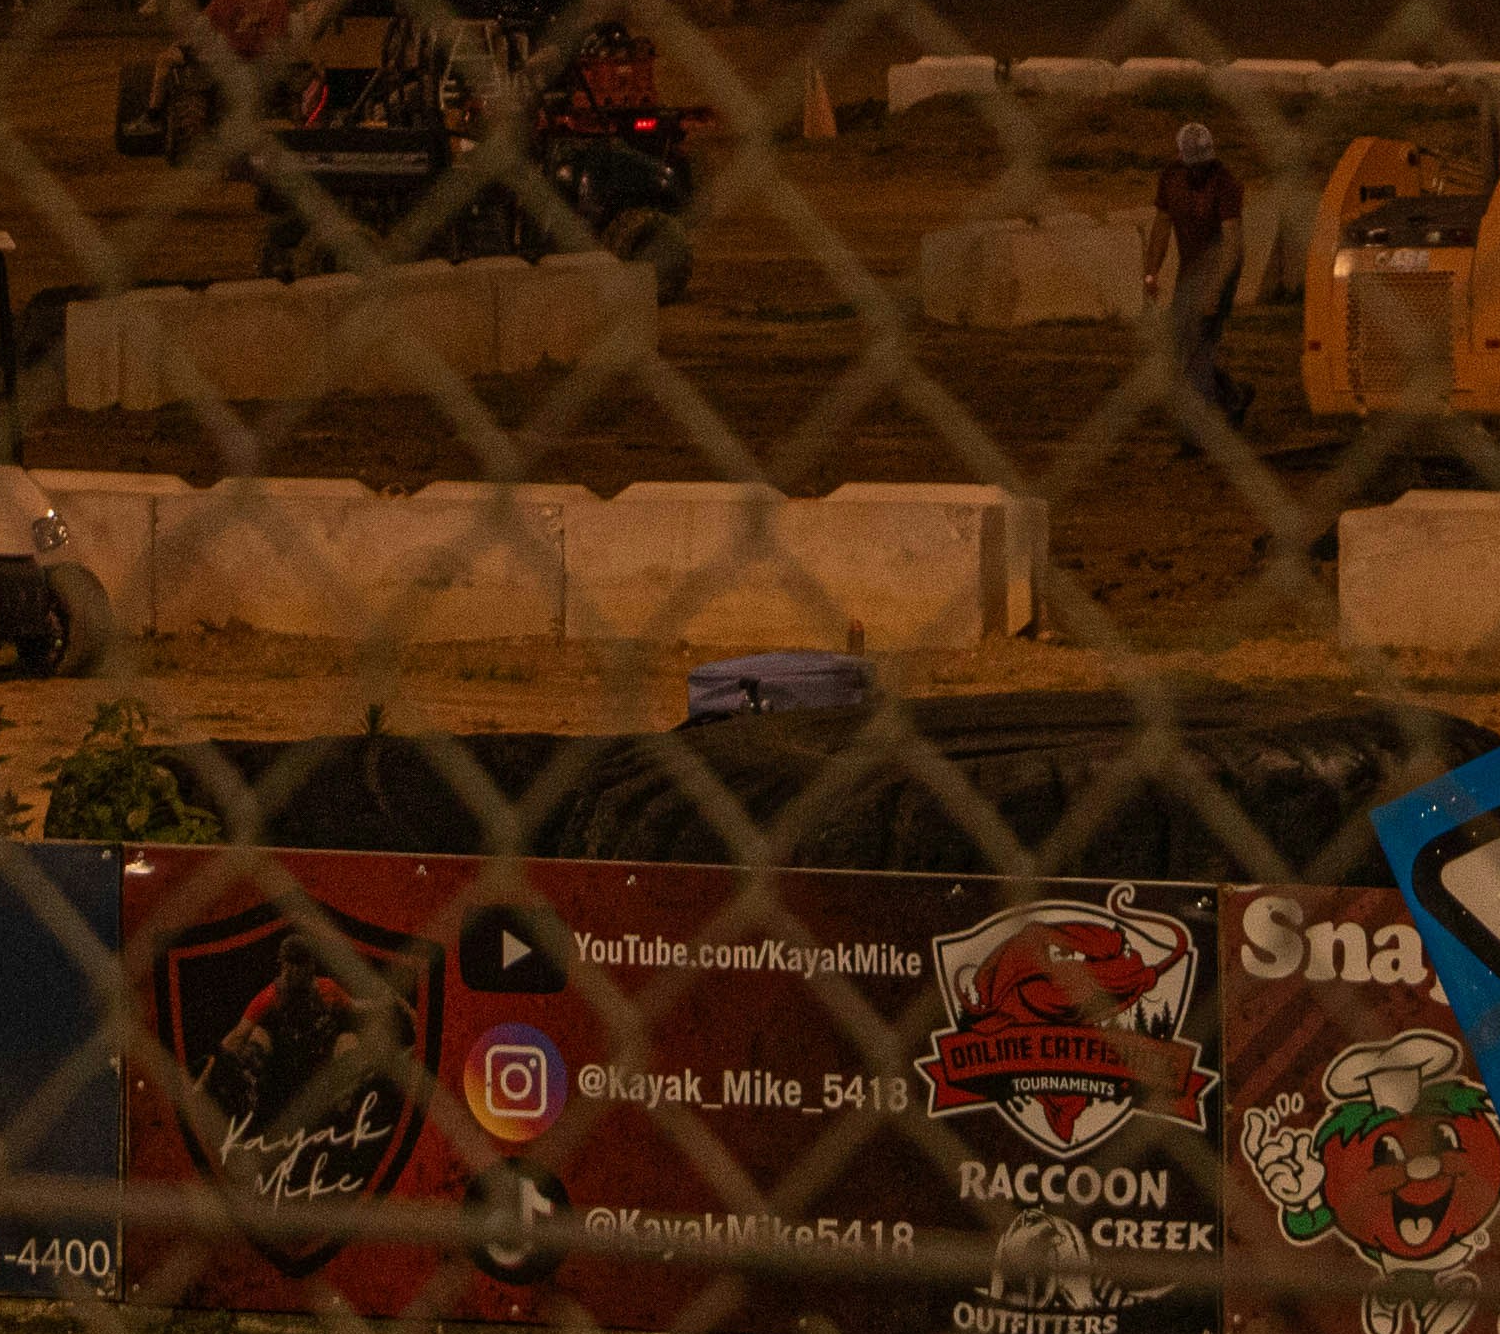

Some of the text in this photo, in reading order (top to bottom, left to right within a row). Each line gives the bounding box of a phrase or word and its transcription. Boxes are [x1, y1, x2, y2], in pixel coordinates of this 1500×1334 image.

[573, 931, 923, 981] YouTube.com/KayakMike
[1240, 895, 1451, 1006] Sna
[576, 1063, 909, 1116] @Kayak_Mike_5418
[1011, 1076, 1117, 1098] TOURNAMENTS
[220, 1090, 394, 1166] Kayak
[254, 1151, 365, 1217] Mike
[958, 1161, 1169, 1209] RACCOON
[1090, 1217, 1215, 1253] CREEK
